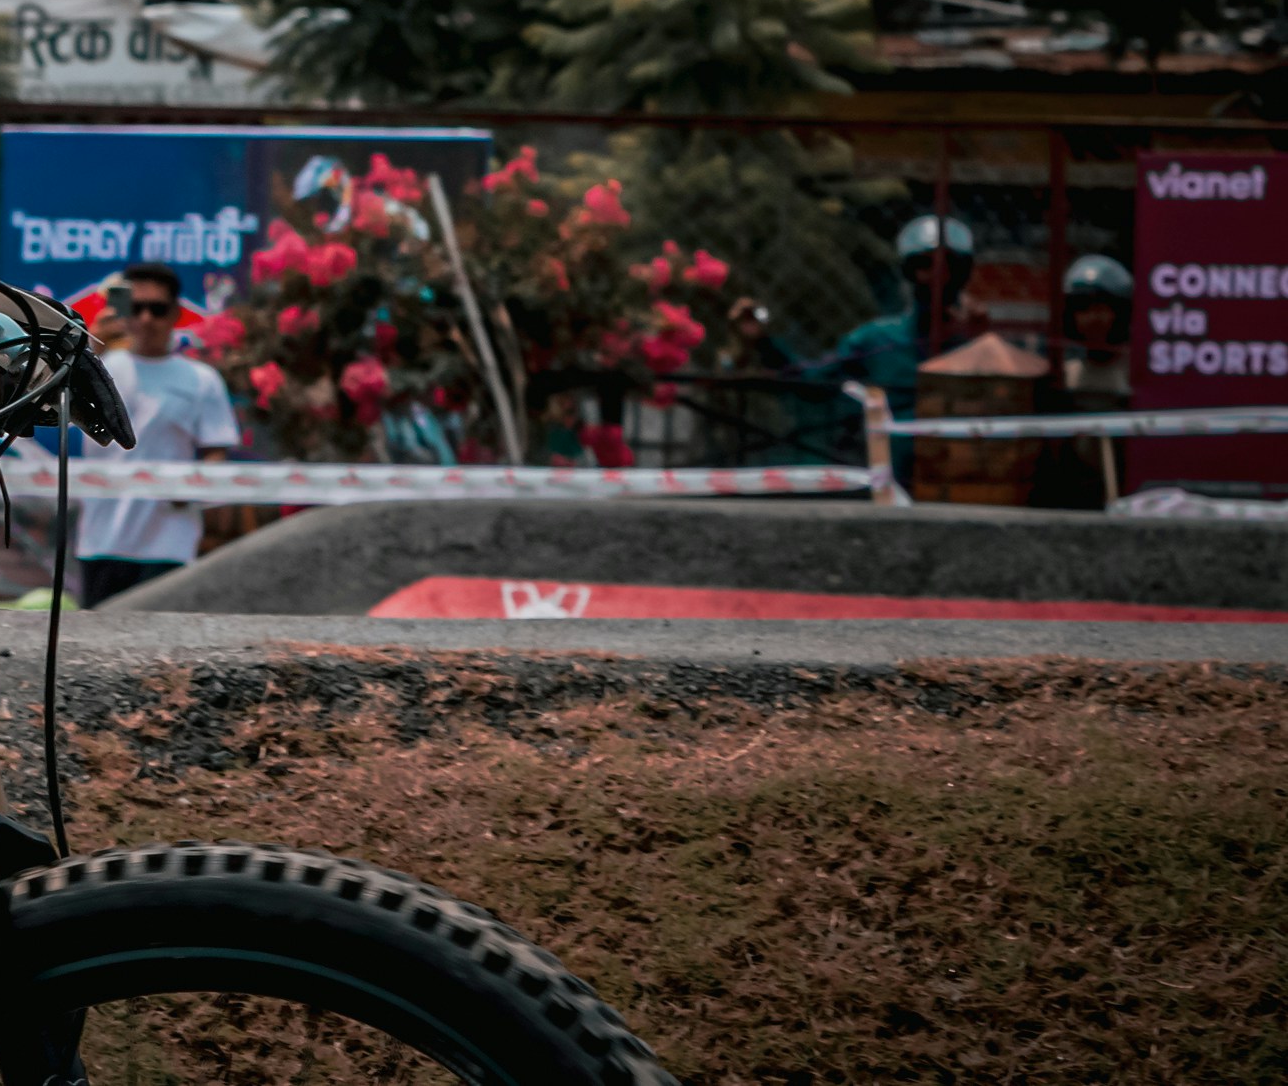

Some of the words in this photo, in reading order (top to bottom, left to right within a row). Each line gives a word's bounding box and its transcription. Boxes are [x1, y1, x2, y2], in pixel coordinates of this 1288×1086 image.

[1145, 161, 1268, 201] vianet
[1148, 262, 1288, 300] CONNE
[1147, 301, 1210, 337] via
[1147, 339, 1288, 377] SPORTS
